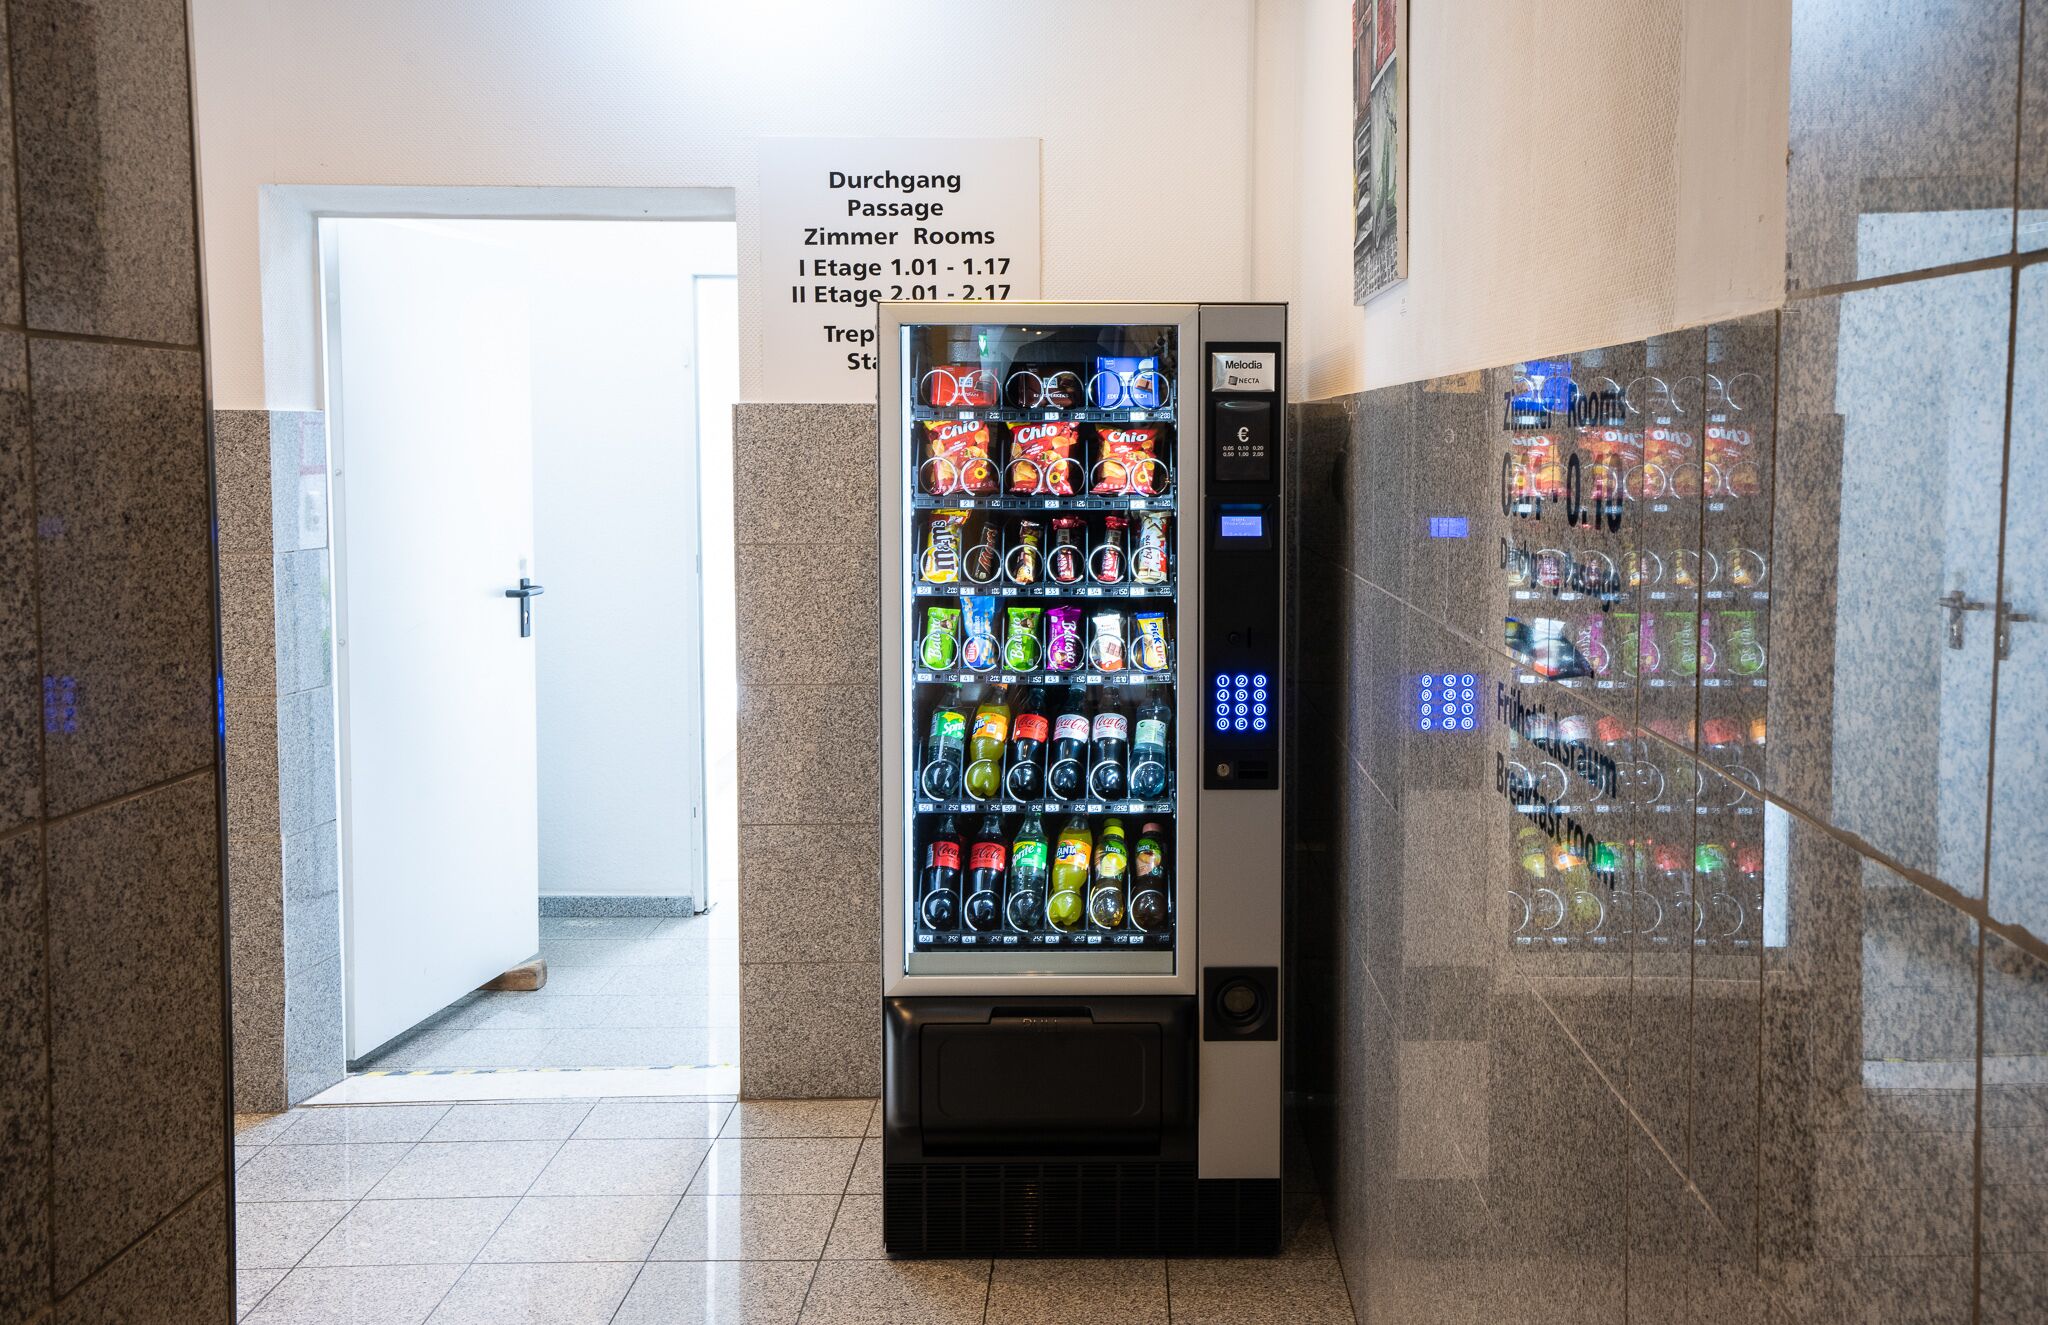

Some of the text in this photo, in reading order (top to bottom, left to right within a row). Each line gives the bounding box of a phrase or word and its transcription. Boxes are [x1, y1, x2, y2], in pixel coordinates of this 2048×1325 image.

[828, 170, 962, 193] Durchgang
[847, 199, 944, 221] Passage
[803, 227, 996, 246] Zimmer Rooms
[799, 259, 805, 276] I
[813, 259, 882, 281] Etage
[890, 258, 937, 276] 1.01
[962, 257, 1011, 276] 1.17
[792, 286, 806, 303] II
[814, 285, 882, 307] Etage
[890, 284, 937, 300] 2.01
[962, 284, 1011, 300] 2.17
[1225, 360, 1263, 370] Melodia
[1238, 377, 1260, 385] NECTA
[1567, 383, 1626, 428] Rooms
[940, 420, 980, 440] Chio
[1017, 423, 1058, 444] Chio
[1107, 431, 1149, 443] Chio
[1237, 426, 1249, 443] €
[1566, 452, 1624, 534] 0.10
[1009, 617, 1025, 662] Balisto
[1061, 620, 1078, 664] Balisto
[1105, 845, 1121, 853] fuze
[1567, 817, 1616, 891] room
